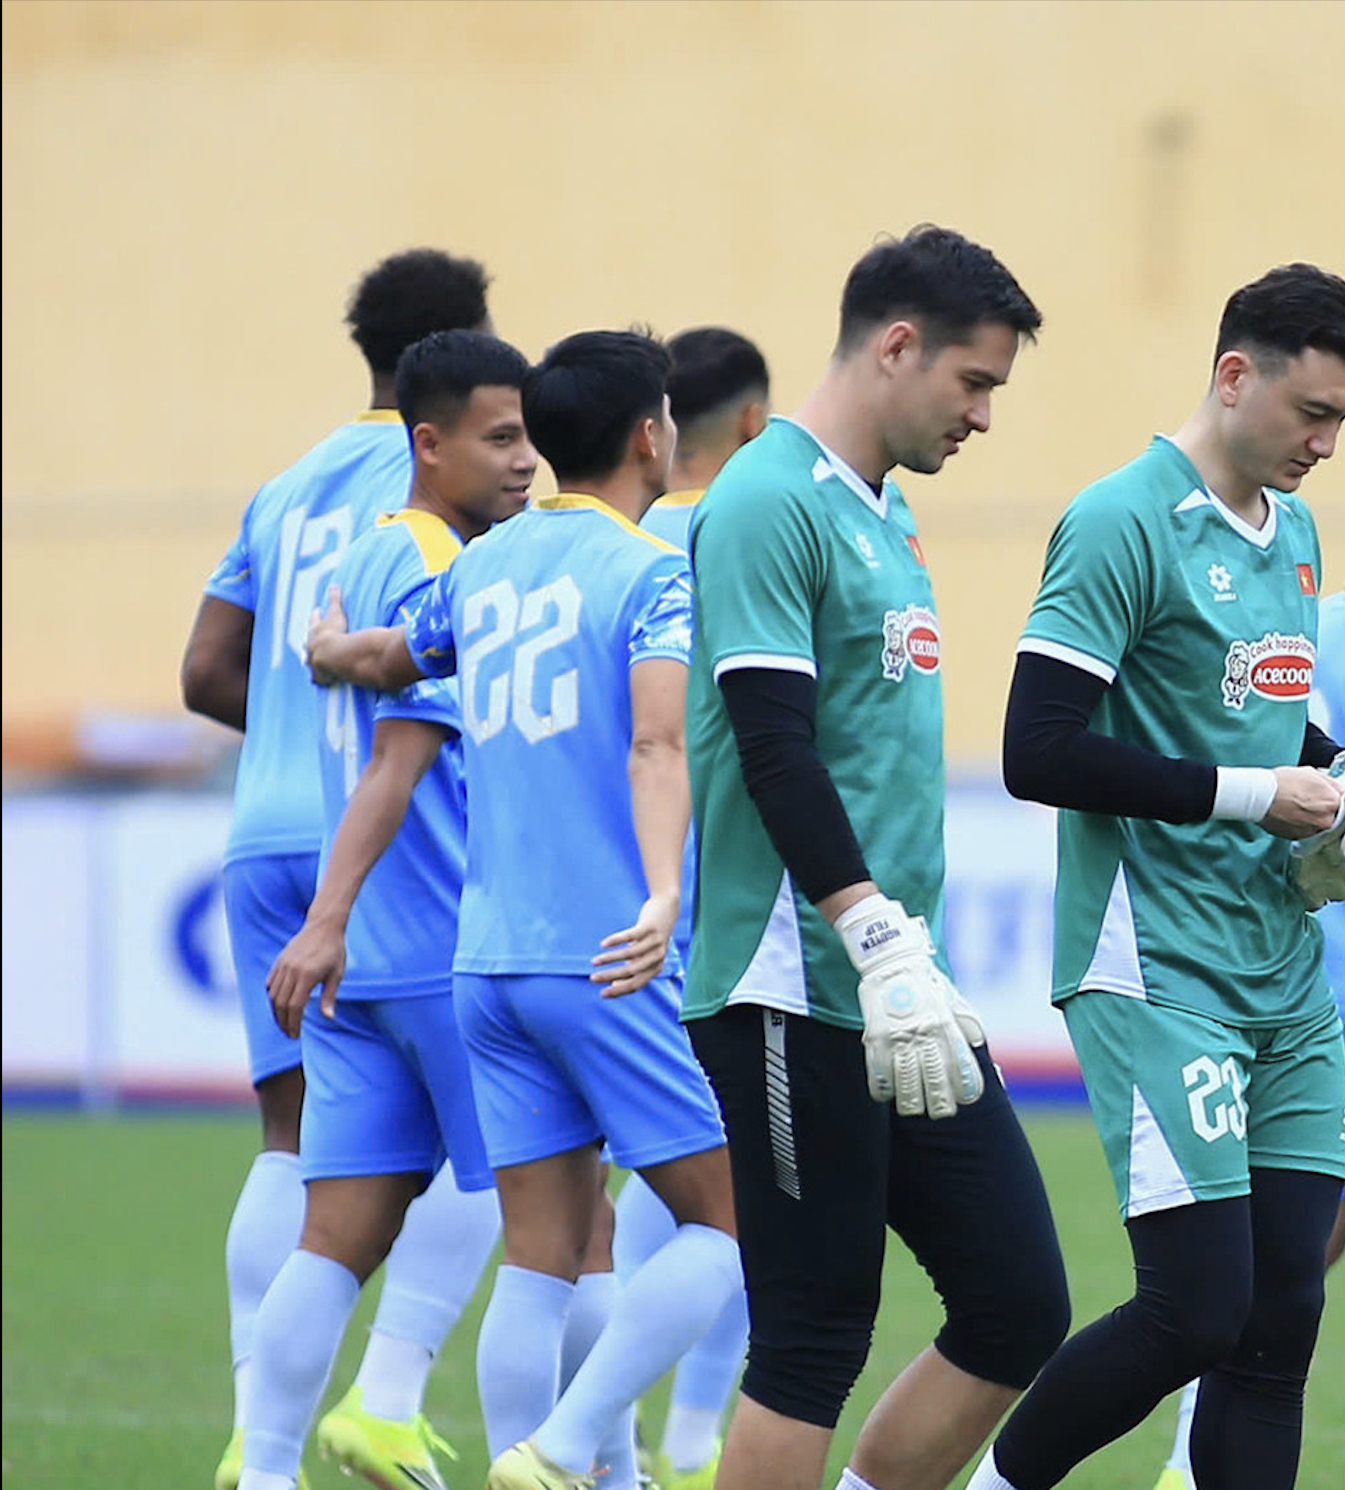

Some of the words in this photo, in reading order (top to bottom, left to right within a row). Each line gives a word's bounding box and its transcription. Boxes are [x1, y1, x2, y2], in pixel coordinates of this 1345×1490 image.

[461, 575, 582, 746] 22
[1250, 637, 1273, 658] Cook
[861, 928, 901, 952] NGUYEN
[1182, 1055, 1247, 1142] 23
